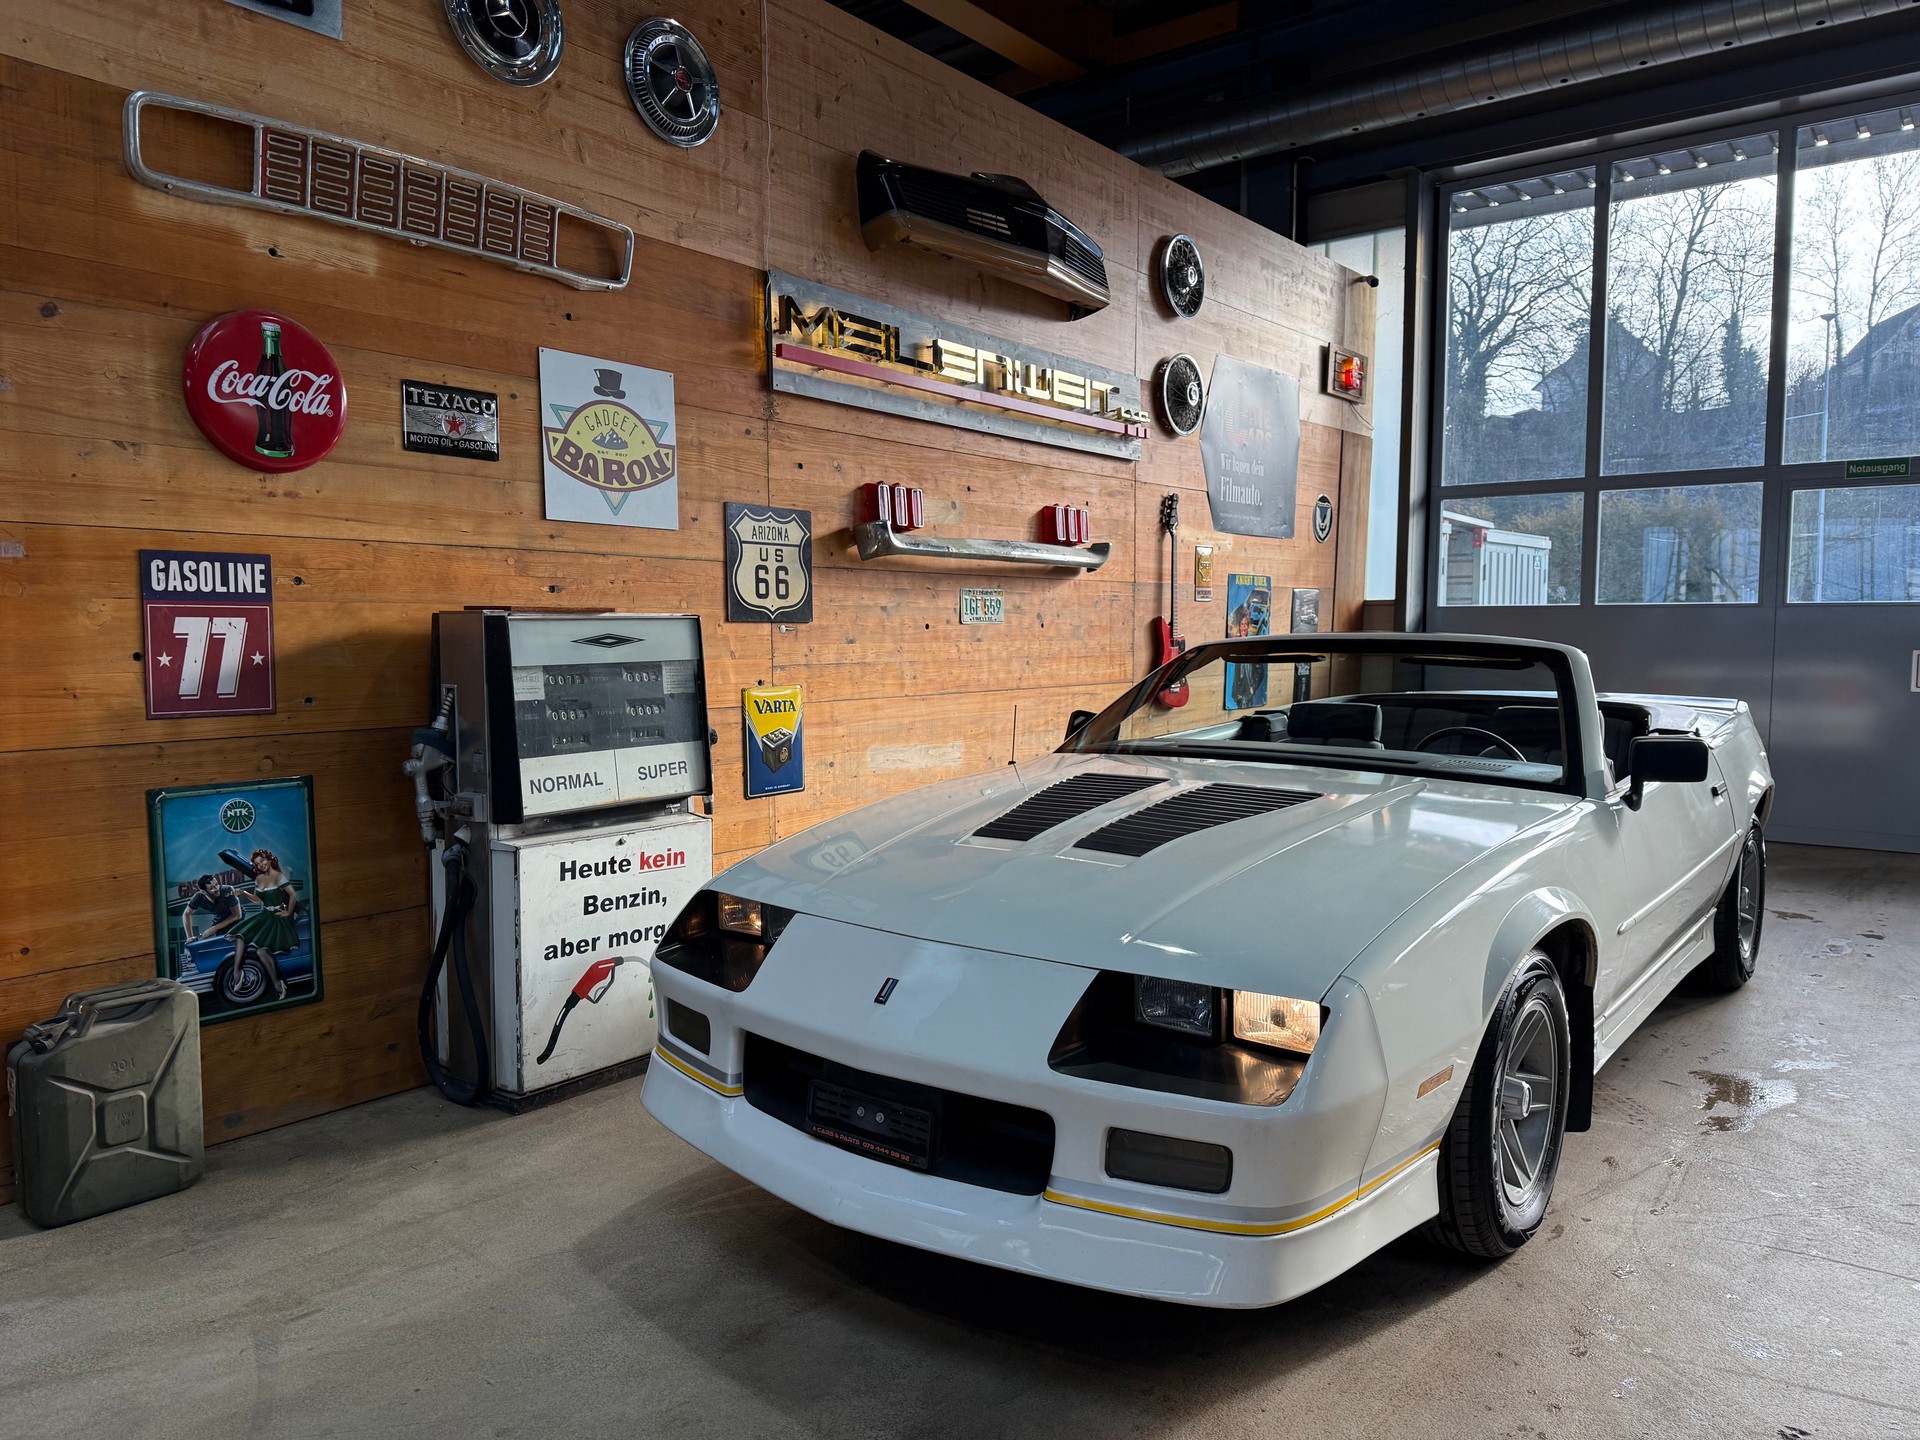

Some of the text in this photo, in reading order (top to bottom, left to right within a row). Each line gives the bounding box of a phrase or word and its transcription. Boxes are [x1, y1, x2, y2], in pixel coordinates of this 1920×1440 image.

[207, 359, 335, 417] Coca-Cola
[407, 386, 496, 415] TEXACO
[583, 408, 639, 437] GADGET
[409, 433, 439, 446] MOTOR
[440, 437, 454, 447] OIL
[553, 435, 671, 487] BARON
[1251, 458, 1265, 477] dein
[1849, 463, 1906, 474] Notausgang
[1219, 476, 1263, 507] Filmauto.
[751, 524, 790, 542] ARIZONA
[150, 558, 267, 594] GASOLINE
[754, 564, 790, 600] 66
[173, 616, 249, 700] 77
[753, 699, 797, 715] VARTA
[529, 771, 604, 795] NORMAL
[637, 760, 689, 781] SUPER
[227, 807, 249, 818] NTK
[559, 848, 687, 882] Heute kein
[583, 886, 667, 916] Benzin,
[543, 936, 601, 961] aber
